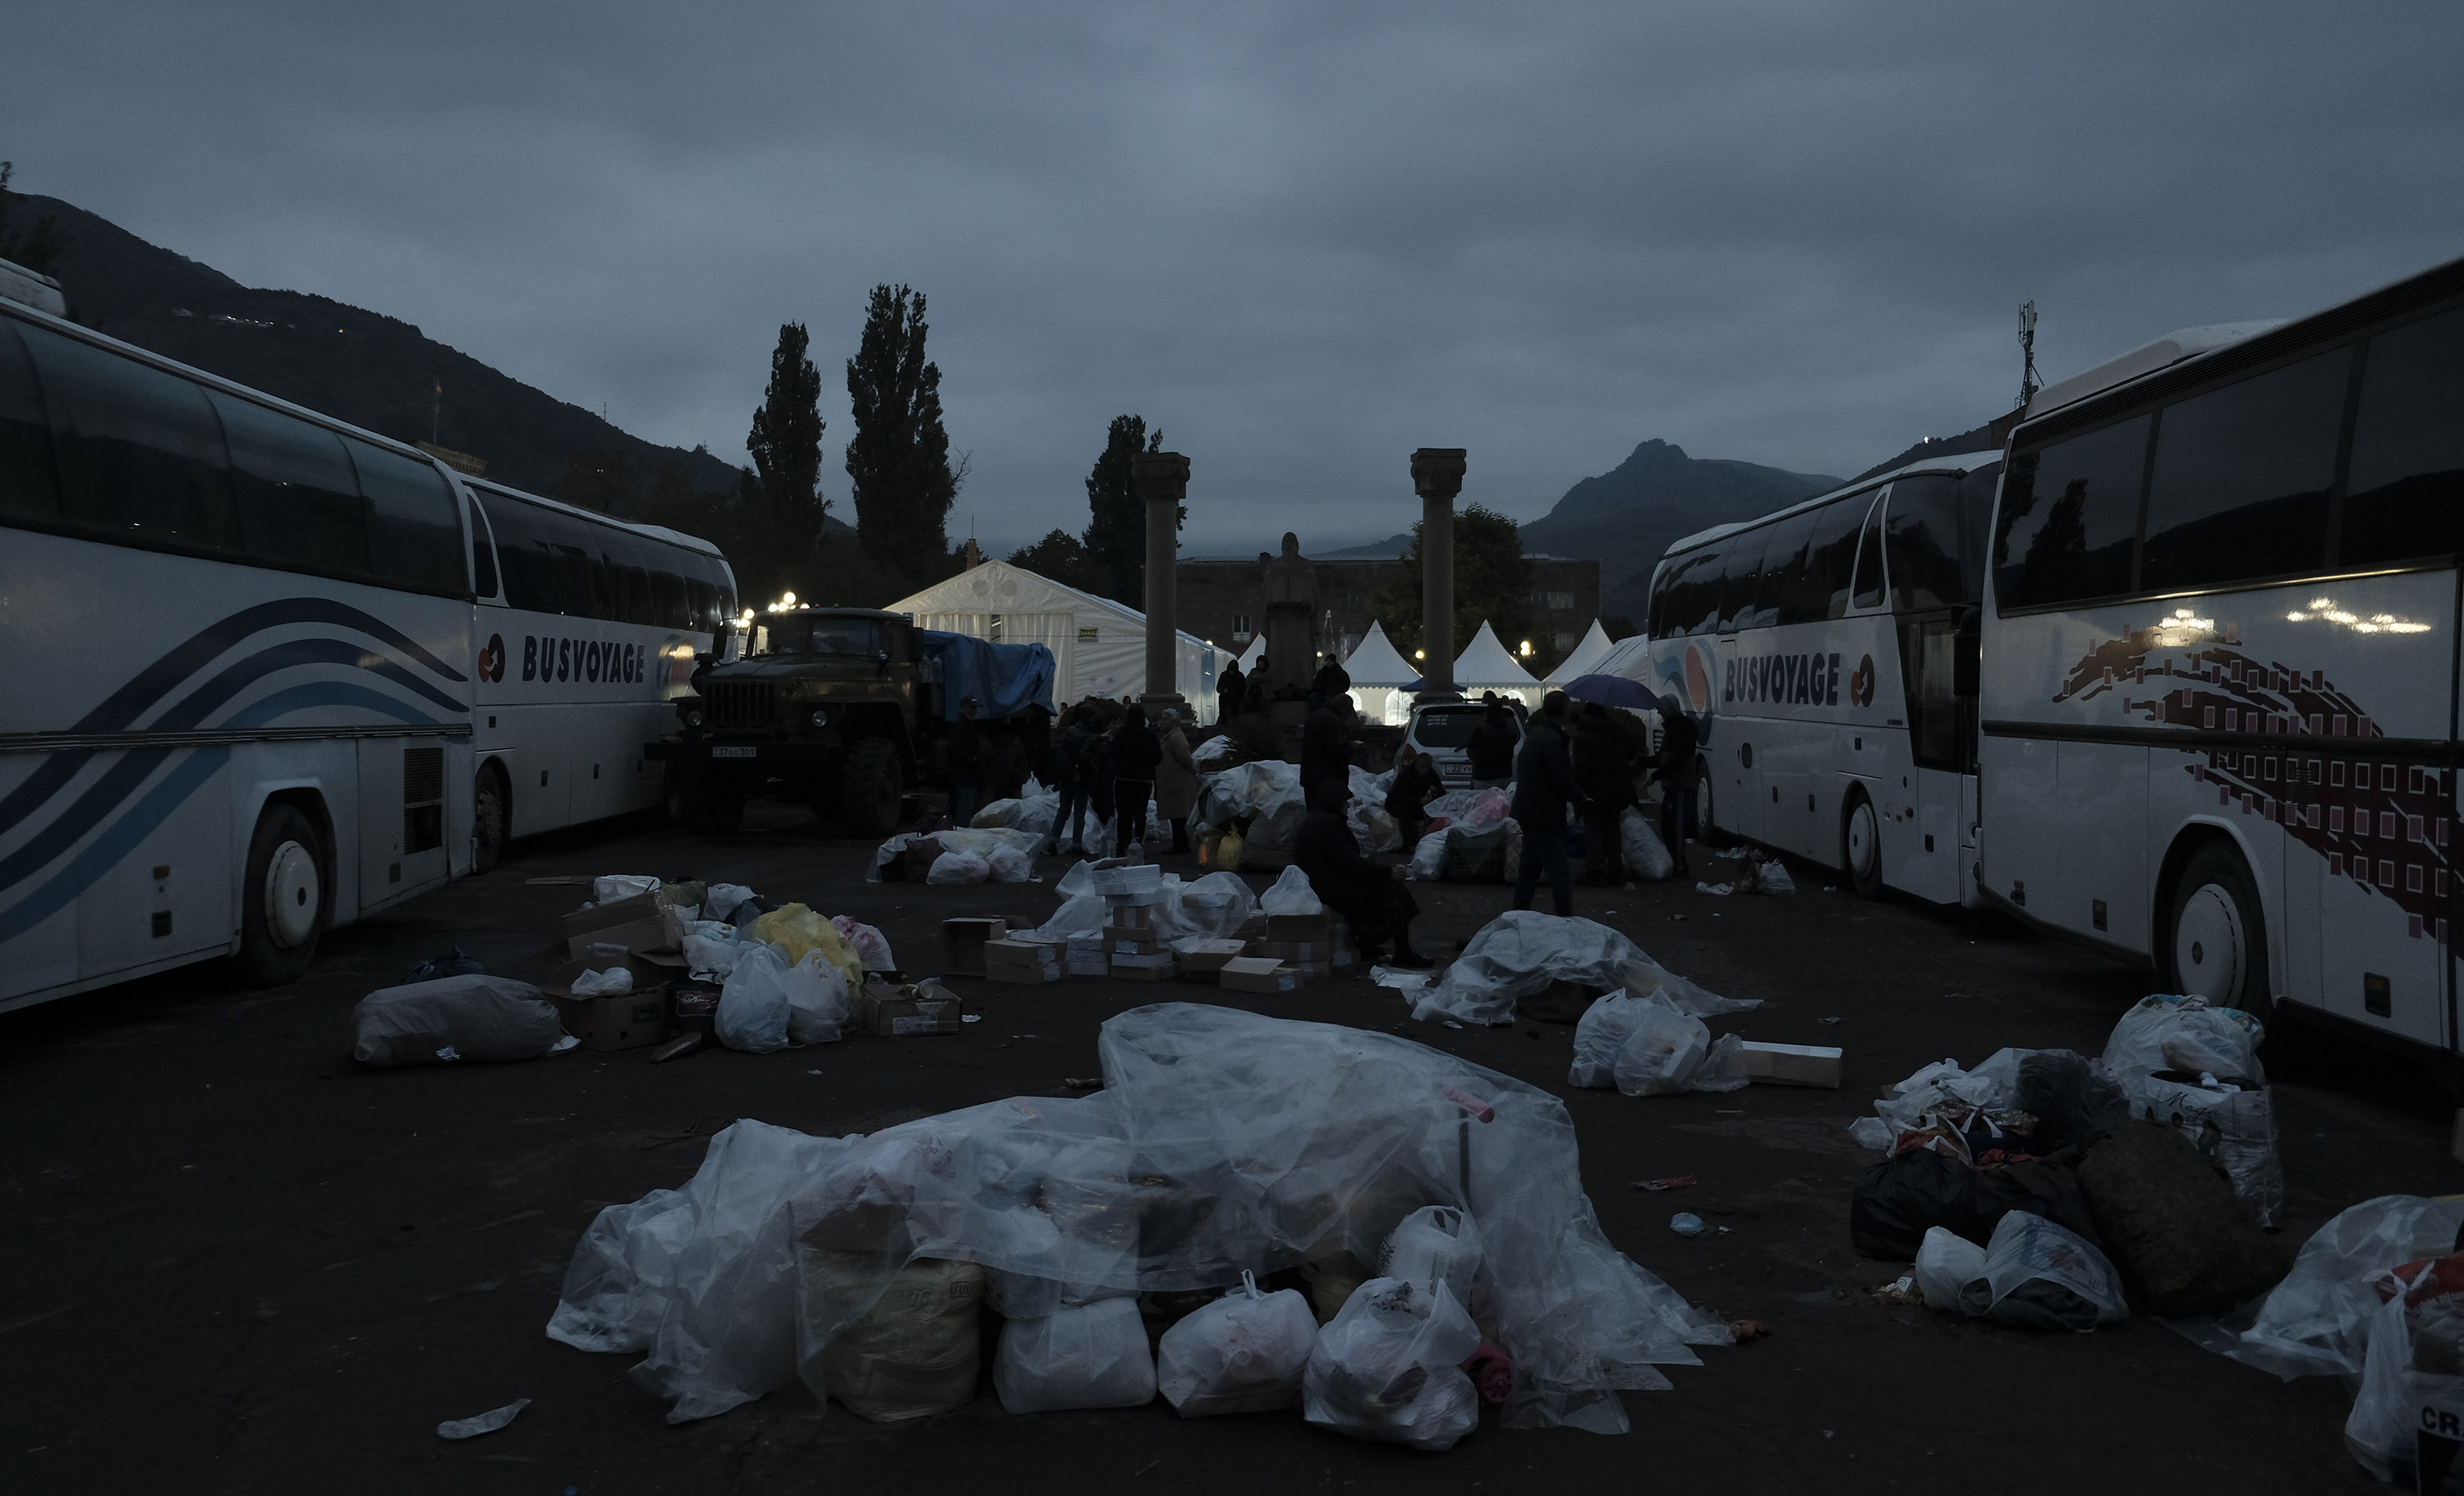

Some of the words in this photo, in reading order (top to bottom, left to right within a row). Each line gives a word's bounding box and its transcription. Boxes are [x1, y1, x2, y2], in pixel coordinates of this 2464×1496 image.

[522, 636, 646, 684] BUSVOYAGE
[1725, 652, 1841, 707] BUSVOYAGE
[2422, 1406, 2464, 1437] CR
